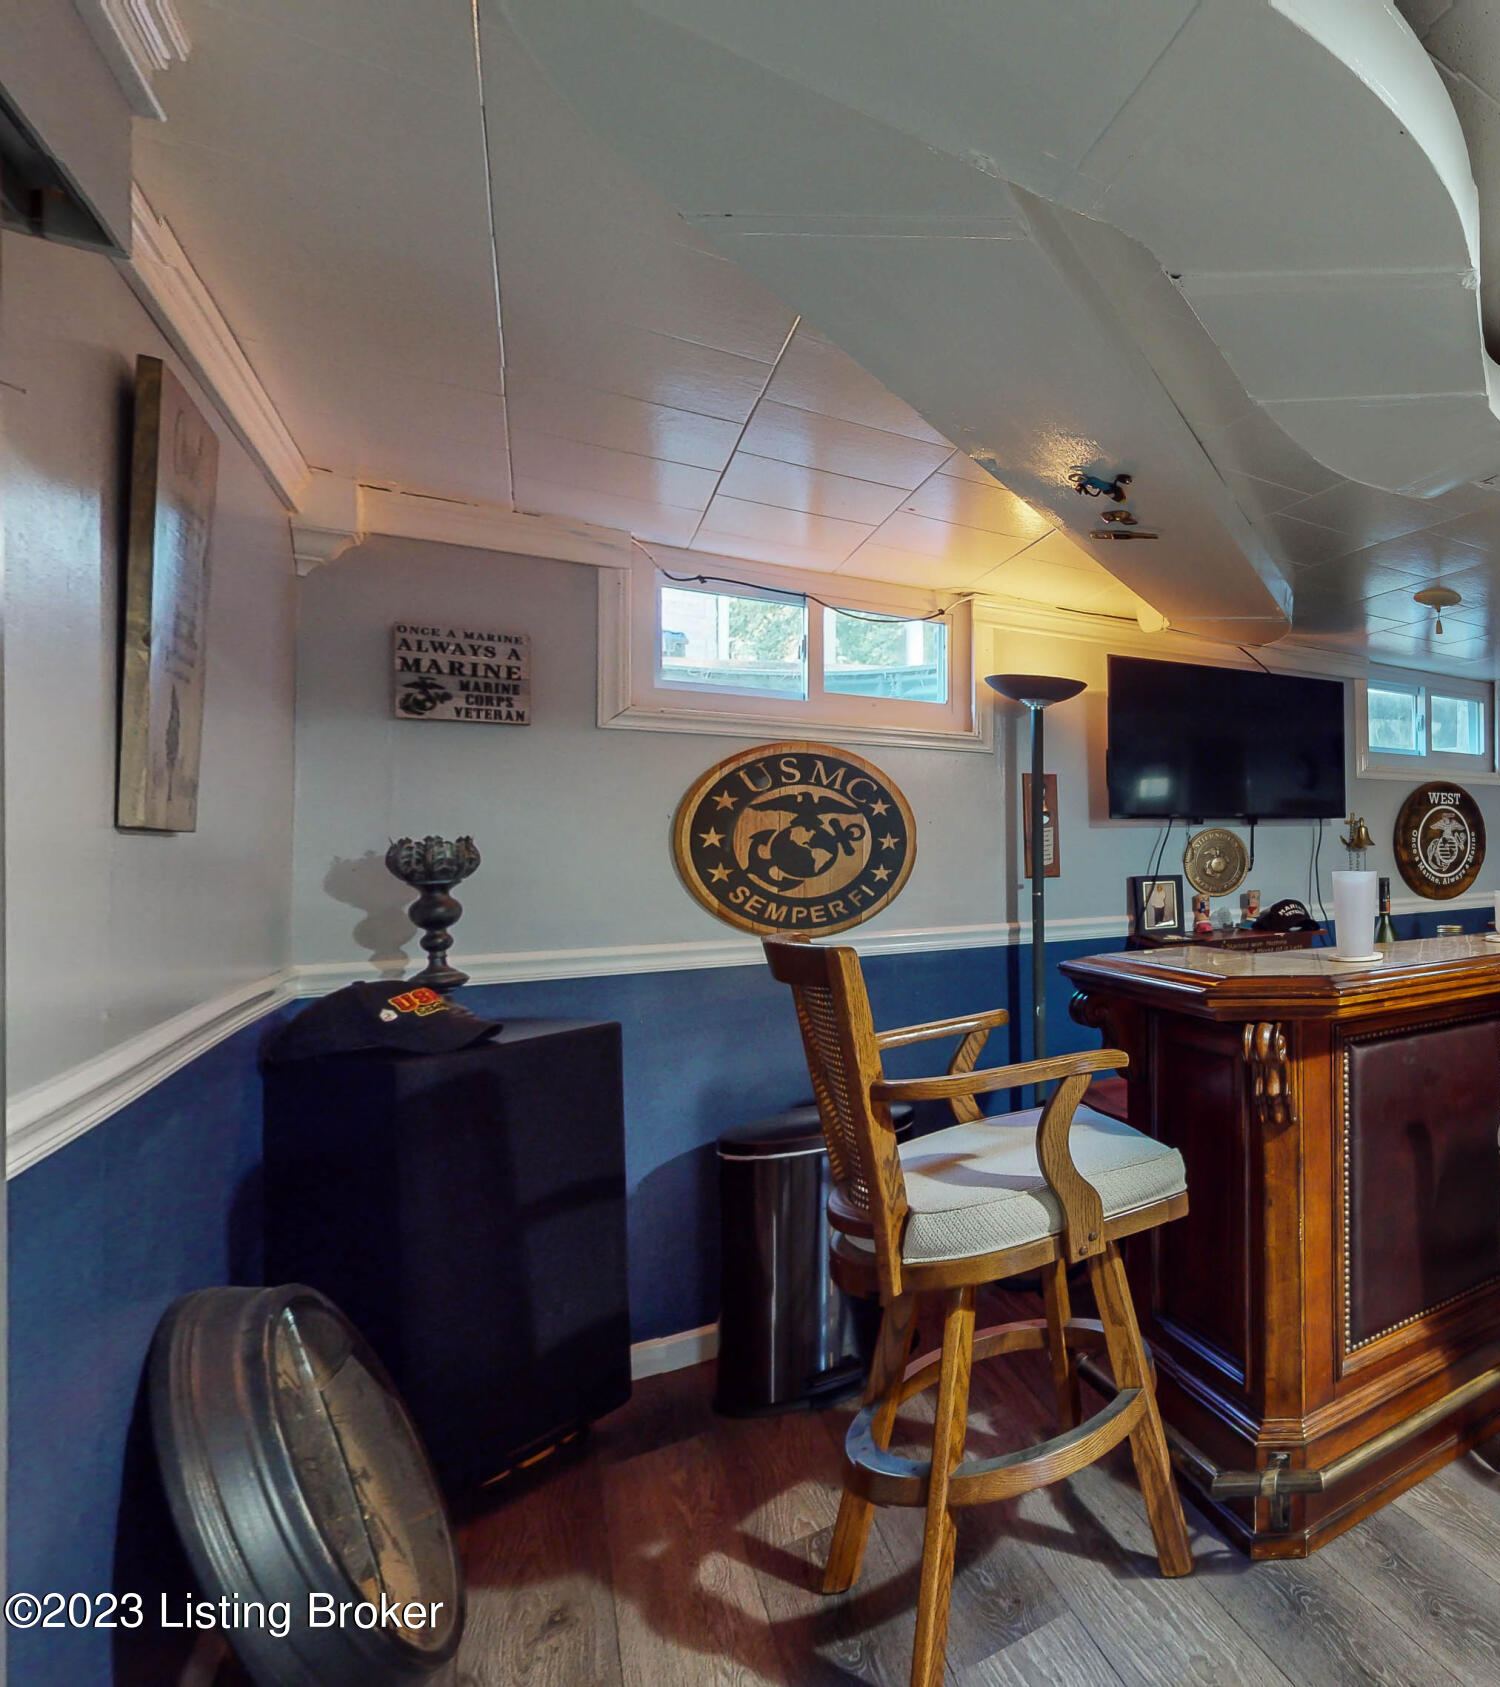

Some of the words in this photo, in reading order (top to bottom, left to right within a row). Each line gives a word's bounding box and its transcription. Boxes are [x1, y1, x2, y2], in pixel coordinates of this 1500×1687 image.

[397, 625, 441, 637] ONCE
[446, 630, 456, 638] A
[464, 631, 523, 645] MARINE
[397, 638, 496, 659] ALWAYS
[507, 648, 522, 661] A
[398, 656, 522, 681] MARINE
[459, 680, 521, 696] MARINE
[465, 694, 514, 709] CORPS
[454, 706, 526, 722] VETERAN
[735, 757, 878, 803] USMC
[1427, 791, 1461, 805] WEST
[1442, 869, 1466, 885] Always
[728, 885, 849, 924] SEMPER
[849, 884, 876, 908] FI
